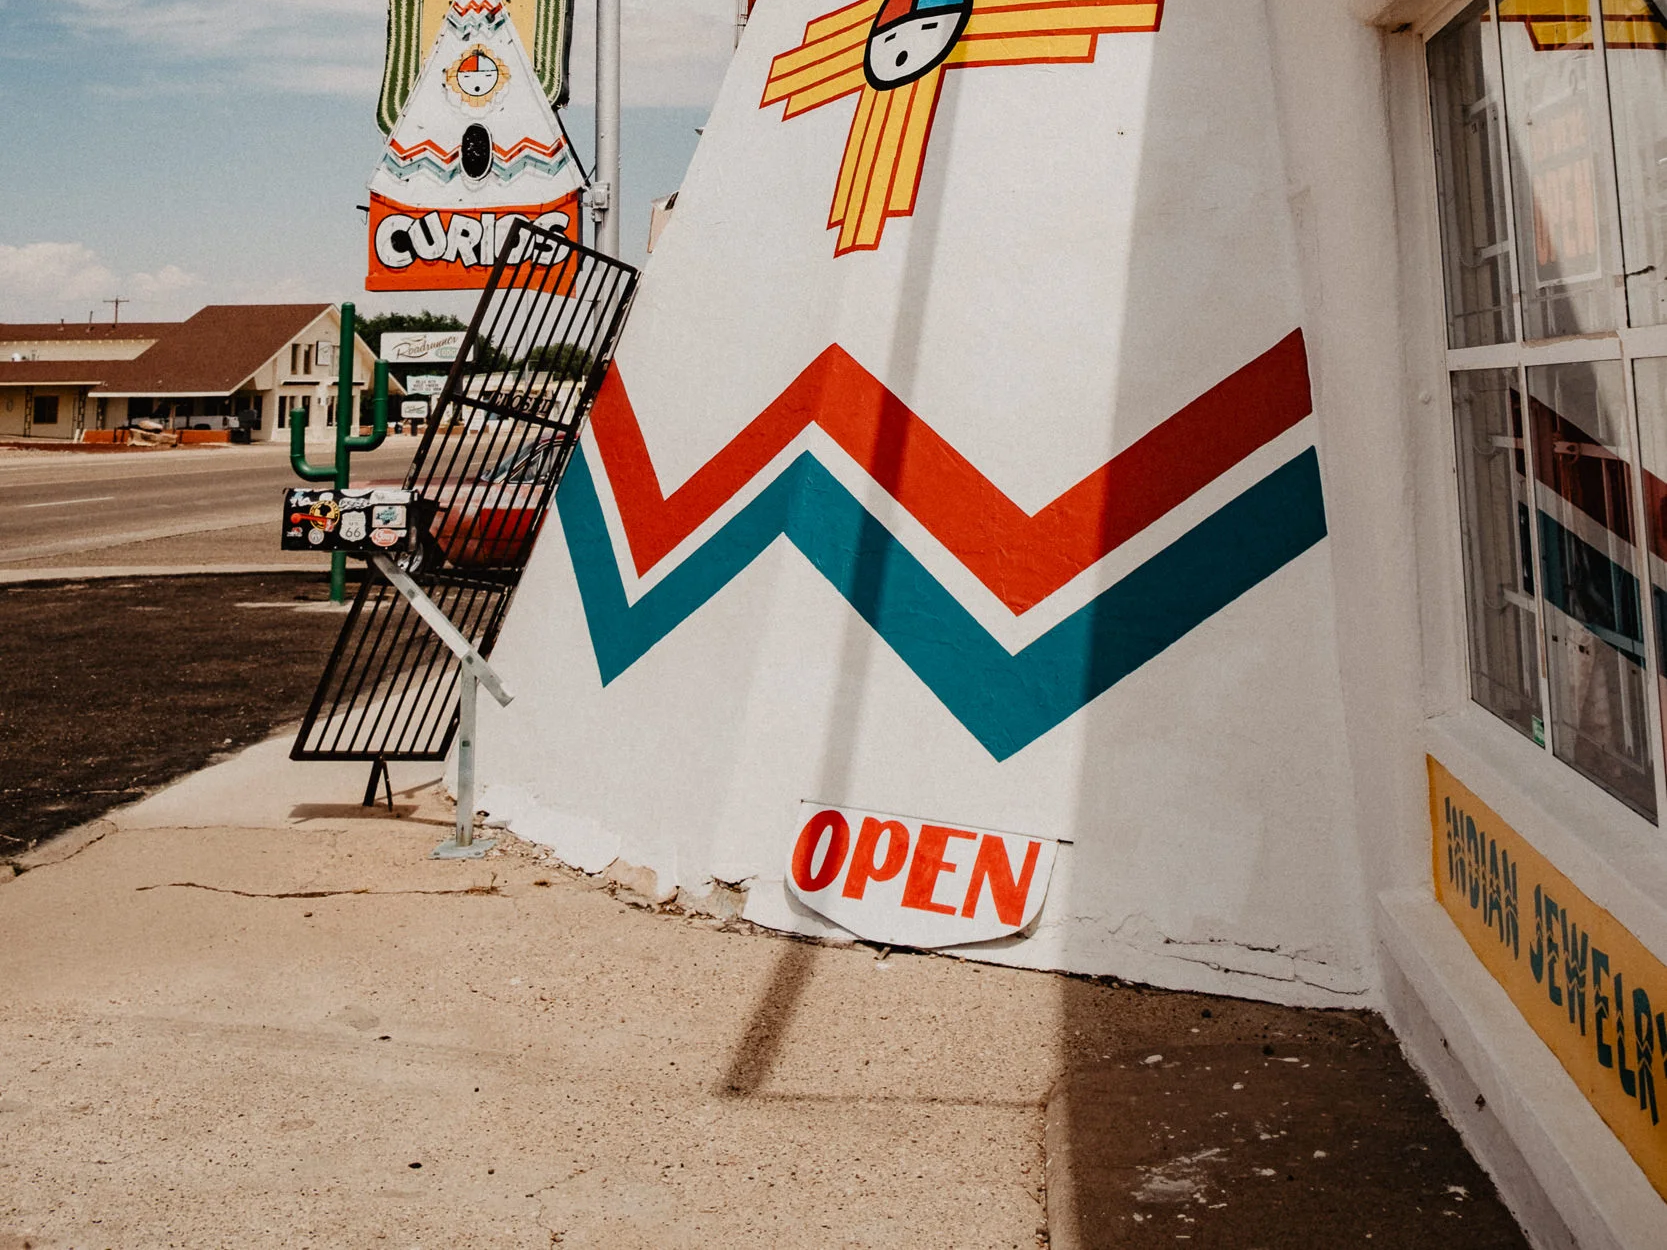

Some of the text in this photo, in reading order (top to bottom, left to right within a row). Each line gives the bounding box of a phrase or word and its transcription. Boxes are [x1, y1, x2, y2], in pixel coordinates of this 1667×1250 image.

[374, 210, 570, 269] CURIOS
[392, 335, 458, 360] Roadrunner
[345, 527, 361, 538] 66
[791, 809, 1042, 927] OPEN
[1445, 796, 1519, 961] INDIAN
